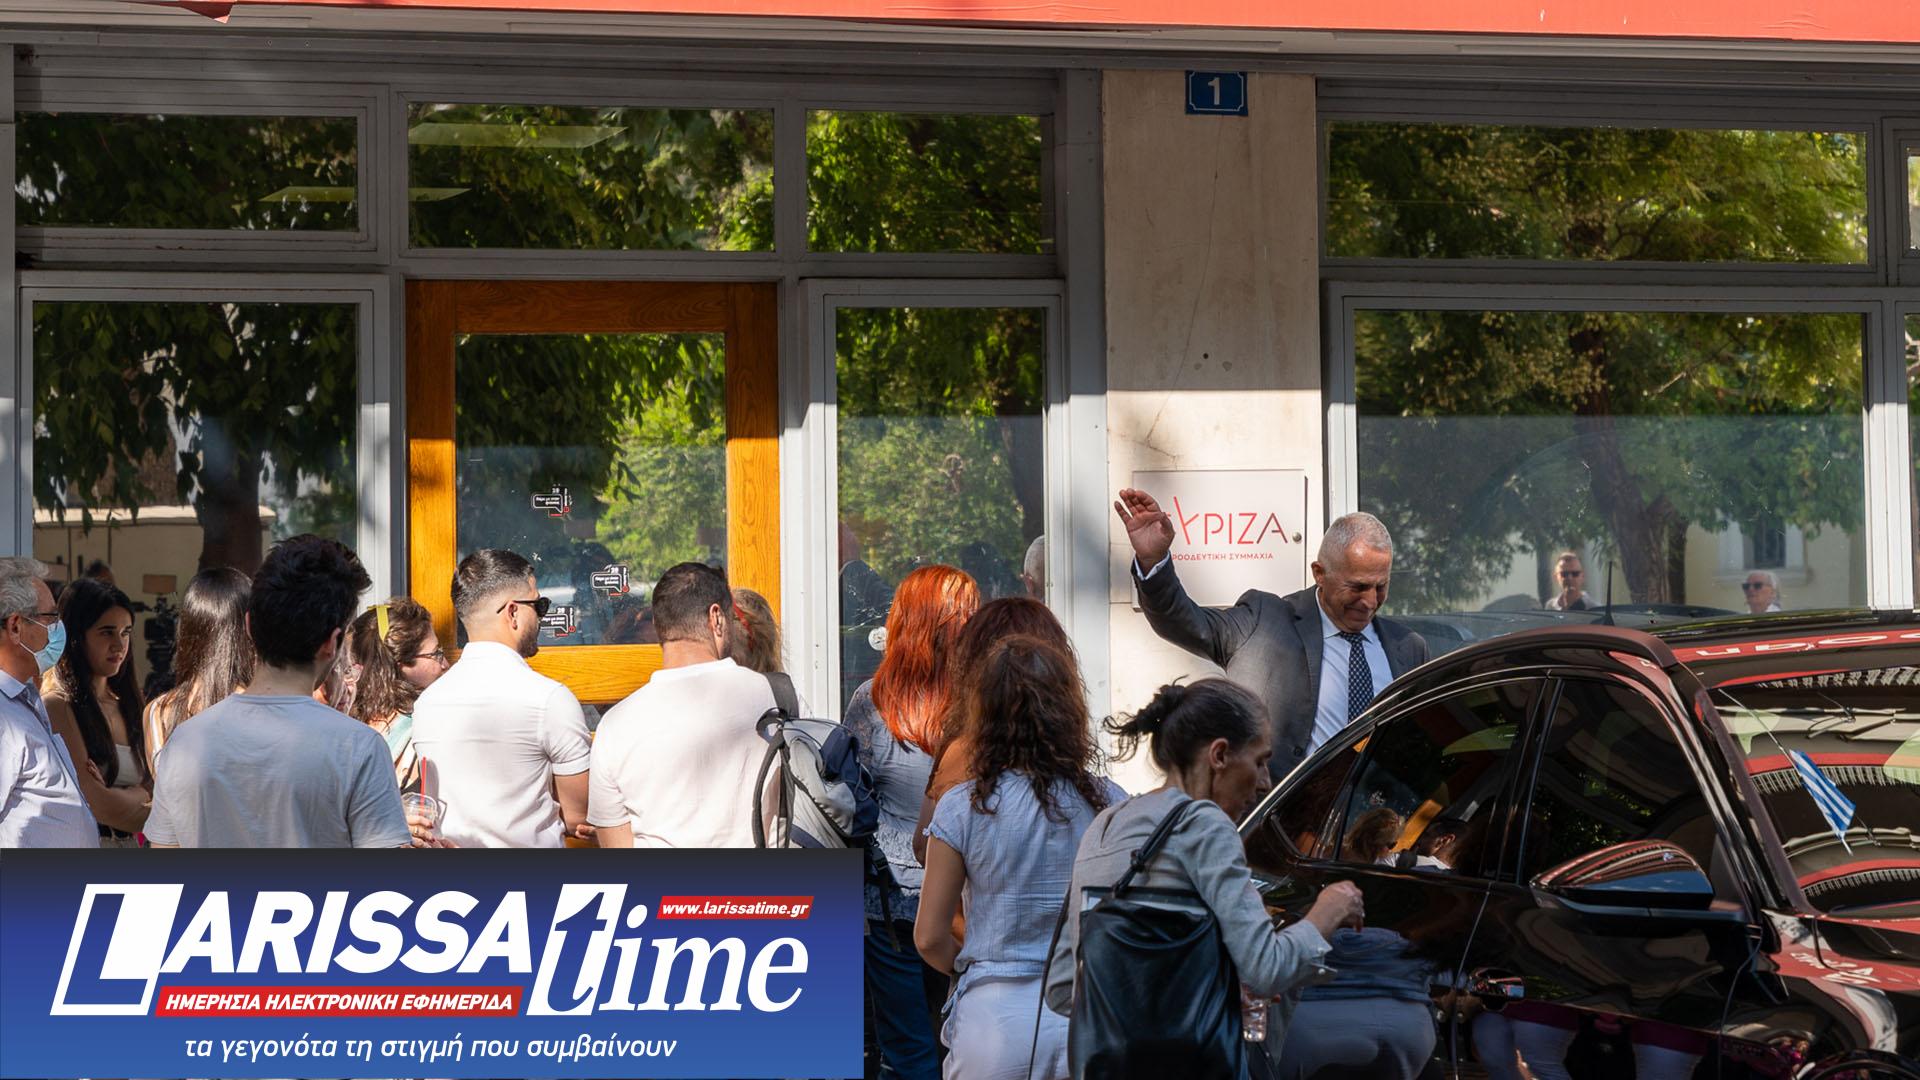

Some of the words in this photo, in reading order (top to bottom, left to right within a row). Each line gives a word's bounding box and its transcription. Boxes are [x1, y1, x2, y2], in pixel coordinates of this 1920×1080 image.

[1207, 77, 1220, 105] 1
[1167, 496, 1288, 545] ΥΡΙΖΑ
[1172, 552, 1226, 561] ΡΟΟΔΕΥΤΙΚΗ
[1229, 552, 1273, 561] ΣΥΜΜΑΧΙΑ
